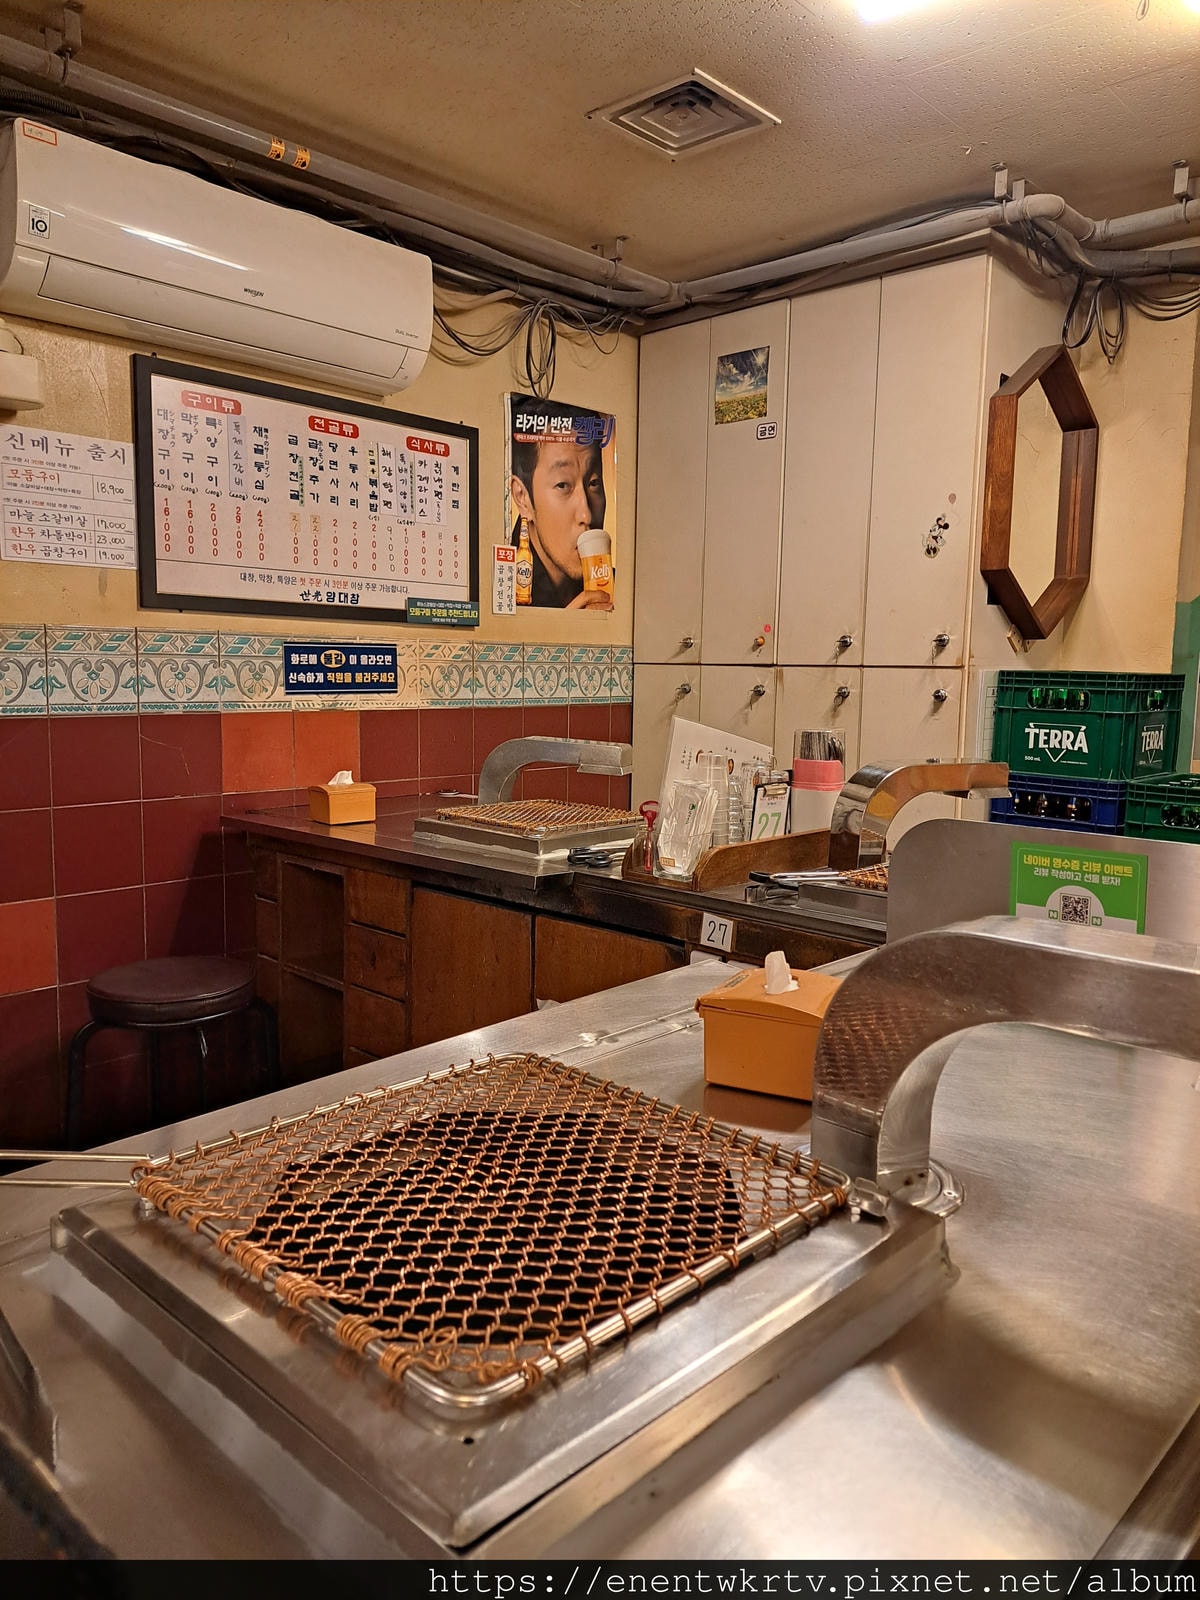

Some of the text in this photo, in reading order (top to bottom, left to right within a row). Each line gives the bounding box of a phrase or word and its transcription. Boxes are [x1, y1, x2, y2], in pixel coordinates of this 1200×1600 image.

[187, 393, 236, 413] 구이류
[314, 418, 354, 437] 전골류
[515, 413, 549, 433] 라거의
[550, 415, 573, 434] 반전
[759, 425, 775, 437] 금연
[5, 431, 126, 465] 신메뉴 출시
[411, 439, 446, 455] 식사류
[7, 468, 60, 485] 모둠구이
[9, 508, 88, 528] 마늘 소갈비살
[40, 545, 88, 559] 곱창구이
[498, 549, 514, 561] 포장
[591, 564, 610, 580] Kelly
[309, 578, 321, 587] 주문
[324, 579, 330, 588] 시
[332, 580, 349, 590] 3인분
[351, 581, 363, 590] 이상
[365, 583, 378, 592] 주문
[290, 653, 318, 665] 화로에
[288, 672, 395, 684] 신속하게 직원을 불러주세요
[1025, 726, 1089, 754] TERRA
[1141, 729, 1164, 753] TERRA
[757, 812, 782, 840] 27
[1023, 854, 1133, 878] 네이버 영수증 리뷰 이벤트
[1034, 867, 1049, 877] 리뷰
[1051, 869, 1082, 881] 작성하고
[1084, 873, 1100, 884] 선물
[707, 920, 728, 946] 27
